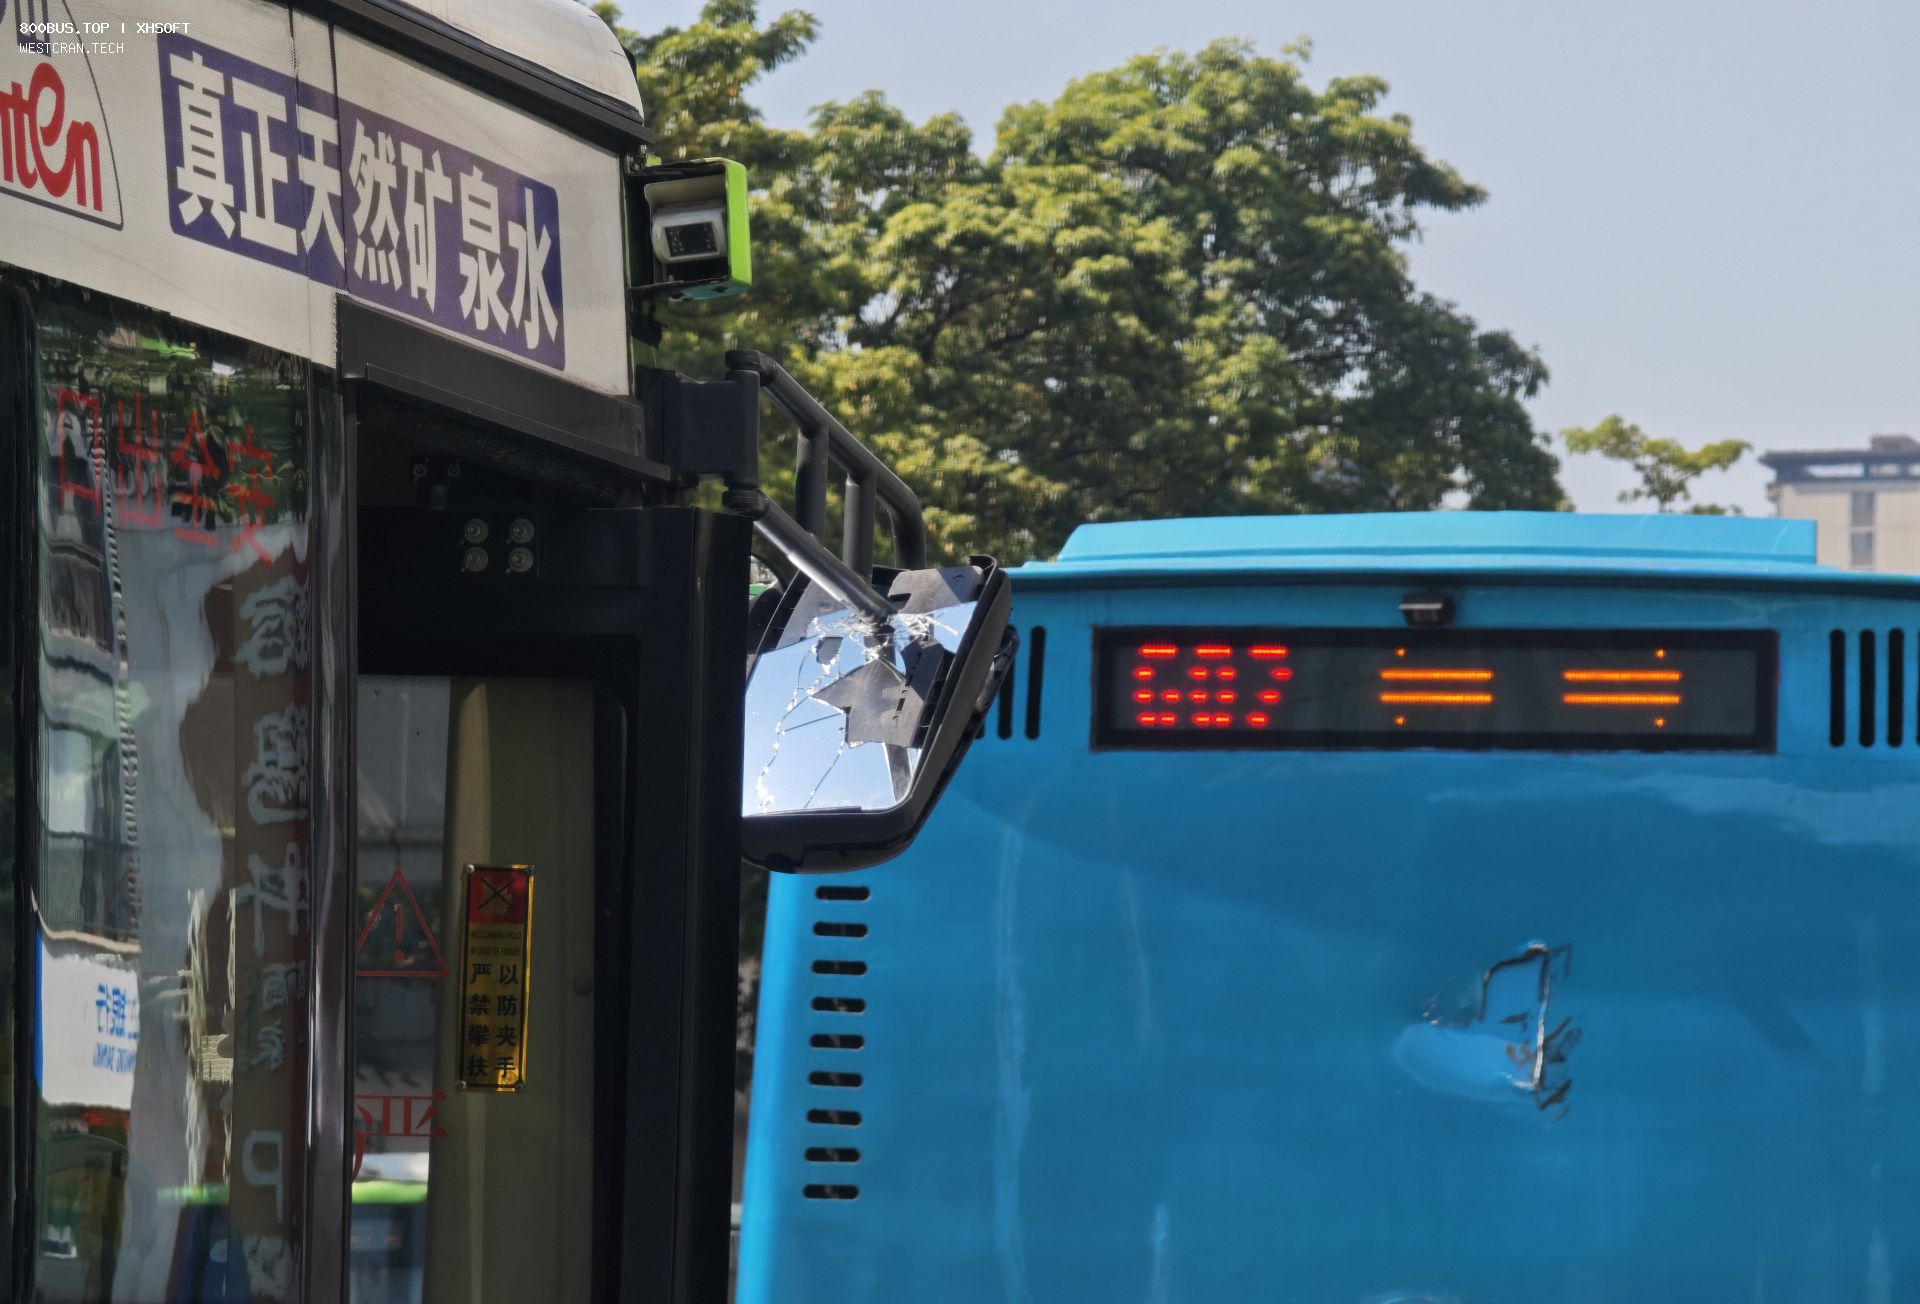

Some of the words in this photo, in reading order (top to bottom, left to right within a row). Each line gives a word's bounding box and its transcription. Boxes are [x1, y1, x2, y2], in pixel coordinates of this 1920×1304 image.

[169, 50, 559, 350] 真正天然矿泉水
[467, 962, 492, 1077] 严禁攀扶
[495, 963, 519, 1078] 以防夹手
